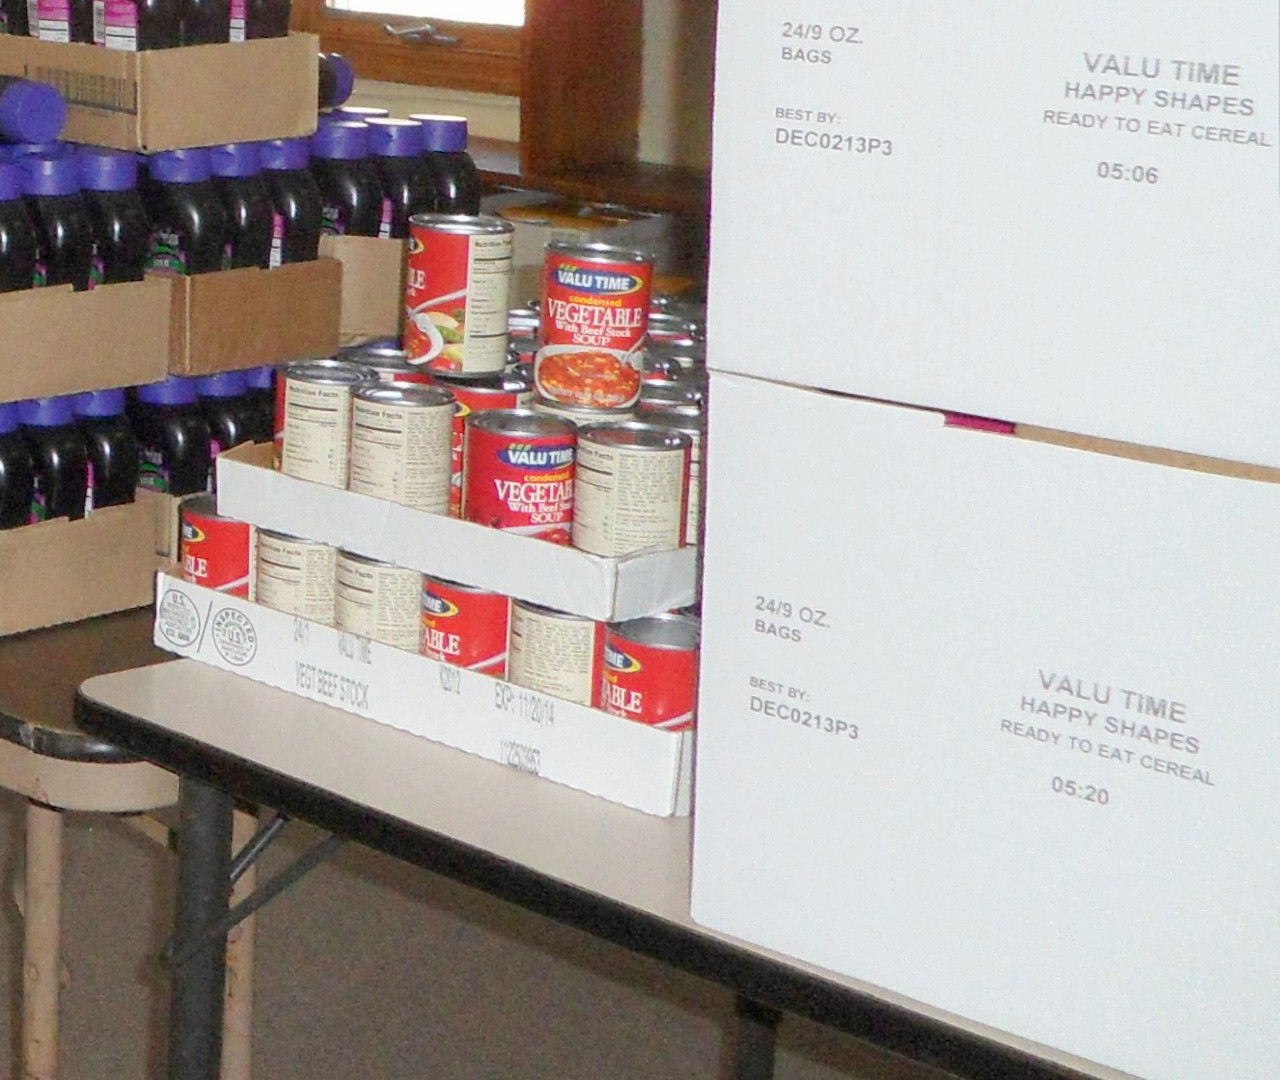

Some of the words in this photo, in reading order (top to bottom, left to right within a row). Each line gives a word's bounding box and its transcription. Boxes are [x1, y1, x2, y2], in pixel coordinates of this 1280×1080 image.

[782, 22, 822, 40] 24/9
[829, 26, 863, 44] OZ.
[782, 47, 831, 64] BAGS
[1083, 52, 1160, 78] VALU
[1171, 60, 1240, 86] TIME
[1065, 82, 1146, 104] HAPPY
[1154, 90, 1254, 116] SHAPES
[776, 107, 813, 121] BEST
[817, 112, 840, 124] BY:
[1043, 110, 1108, 129] READY
[1115, 117, 1140, 132] TO
[1147, 120, 1186, 137] EAT
[1191, 125, 1272, 147] CEREAL
[776, 128, 892, 156] DEC0213P3
[1097, 162, 1159, 184] 05:06
[557, 270, 593, 288] VALU
[595, 275, 631, 291] TIME
[569, 294, 624, 307] condensed
[547, 297, 643, 328] VEGETABLE
[555, 319, 579, 333] With
[581, 321, 604, 336] Beef
[606, 326, 632, 338] Stock
[572, 332, 611, 346] SOUP
[507, 449, 547, 465] VALU
[549, 447, 575, 465] TIME
[523, 471, 570, 483] condensed
[508, 500, 537, 513] With
[538, 500, 558, 513] Beef
[530, 511, 564, 524] SOUP
[755, 596, 792, 618] 24/9
[799, 607, 830, 628] OZ.
[755, 619, 801, 642] BAGS
[750, 676, 783, 693] BEST
[788, 687, 809, 702] BY:
[1039, 669, 1111, 704] VALU
[1120, 689, 1186, 723] TIME
[750, 696, 858, 739] DEC0213P3
[1021, 696, 1098, 727] HAPPY
[1104, 715, 1200, 753] SHAPES
[1000, 719, 1061, 745] READY
[1069, 736, 1092, 753] TO
[1098, 744, 1134, 763] EAT
[1140, 755, 1215, 786] CEREAL
[1052, 776, 1109, 805] 05:20
